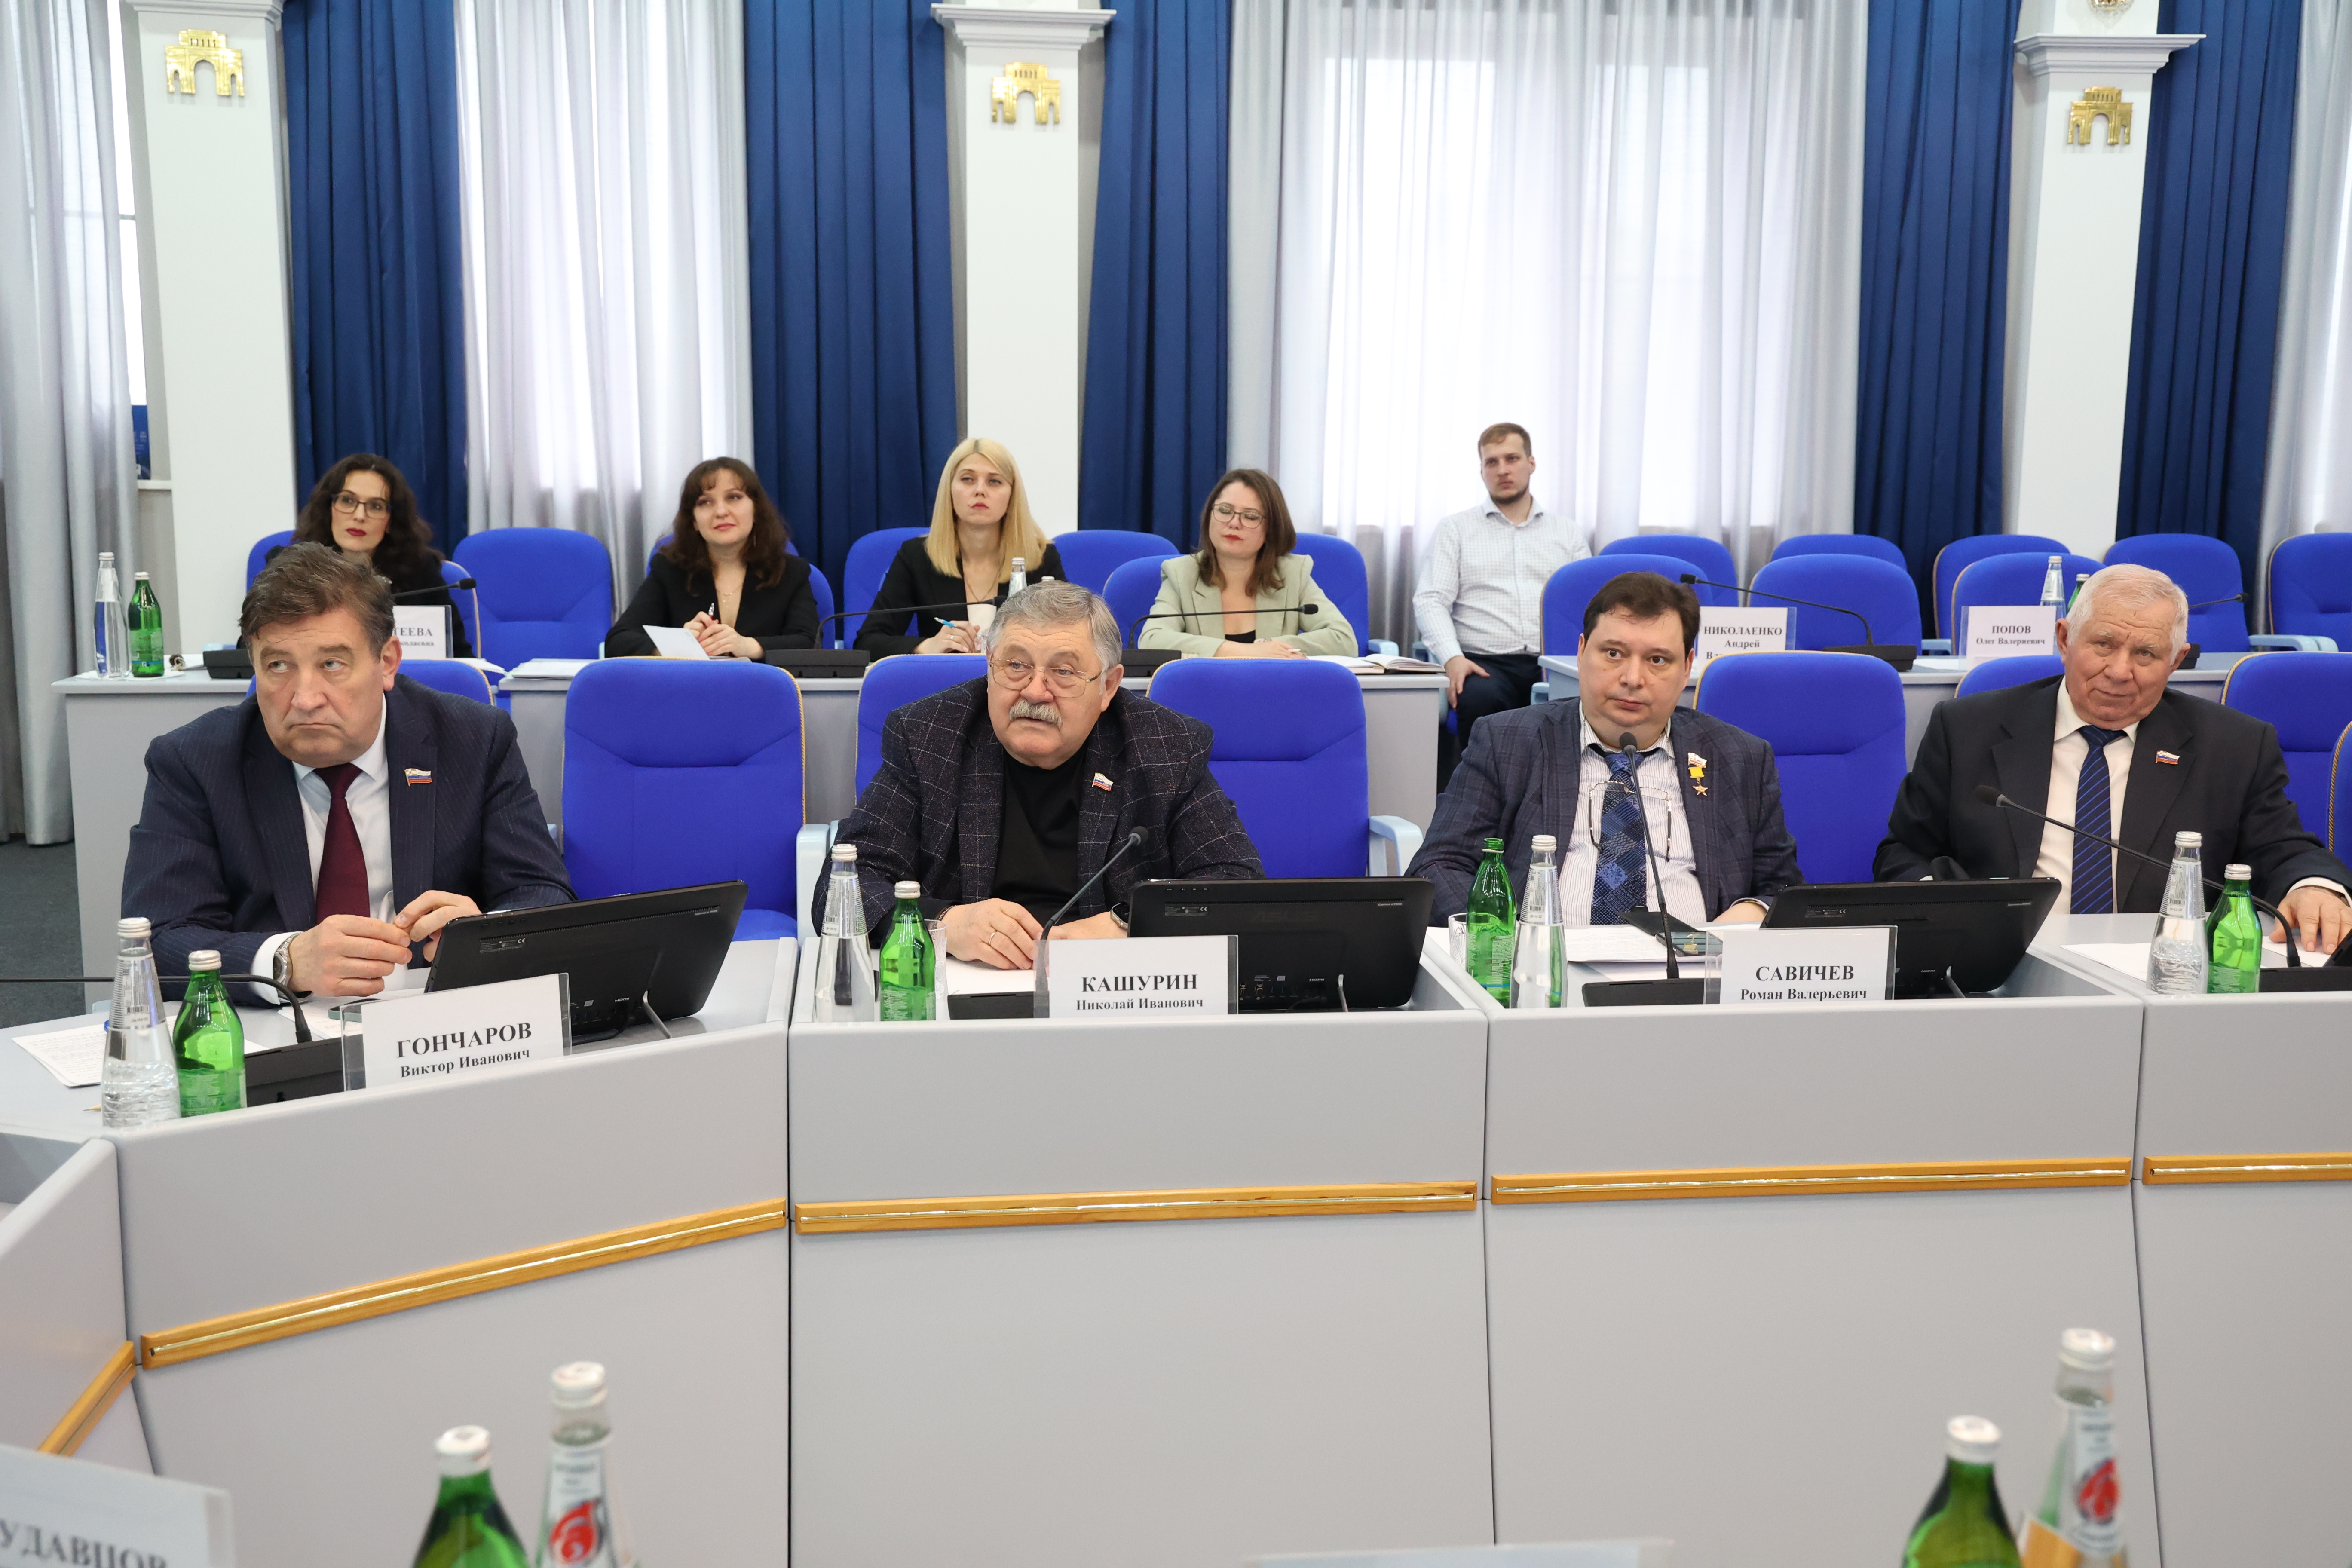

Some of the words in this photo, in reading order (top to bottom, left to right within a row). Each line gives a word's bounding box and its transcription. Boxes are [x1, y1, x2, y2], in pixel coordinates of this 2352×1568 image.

[1704, 626, 1782, 635] НИКОЛАЕНКО
[1992, 625, 2031, 634] ПОПОВ
[1724, 640, 1760, 649] Андрей
[1756, 965, 1854, 981] САВИЧЕВ
[1081, 974, 1198, 992] КАШУРИН
[1741, 989, 1782, 1000] Роман
[1788, 989, 1867, 1001] Валерьевич
[1076, 998, 1133, 1010] Николай
[1139, 998, 1204, 1009] Иванович
[397, 1022, 532, 1058] ГОНЧАРОВ
[401, 1060, 454, 1078] Виктор
[459, 1050, 530, 1068] Иванович
